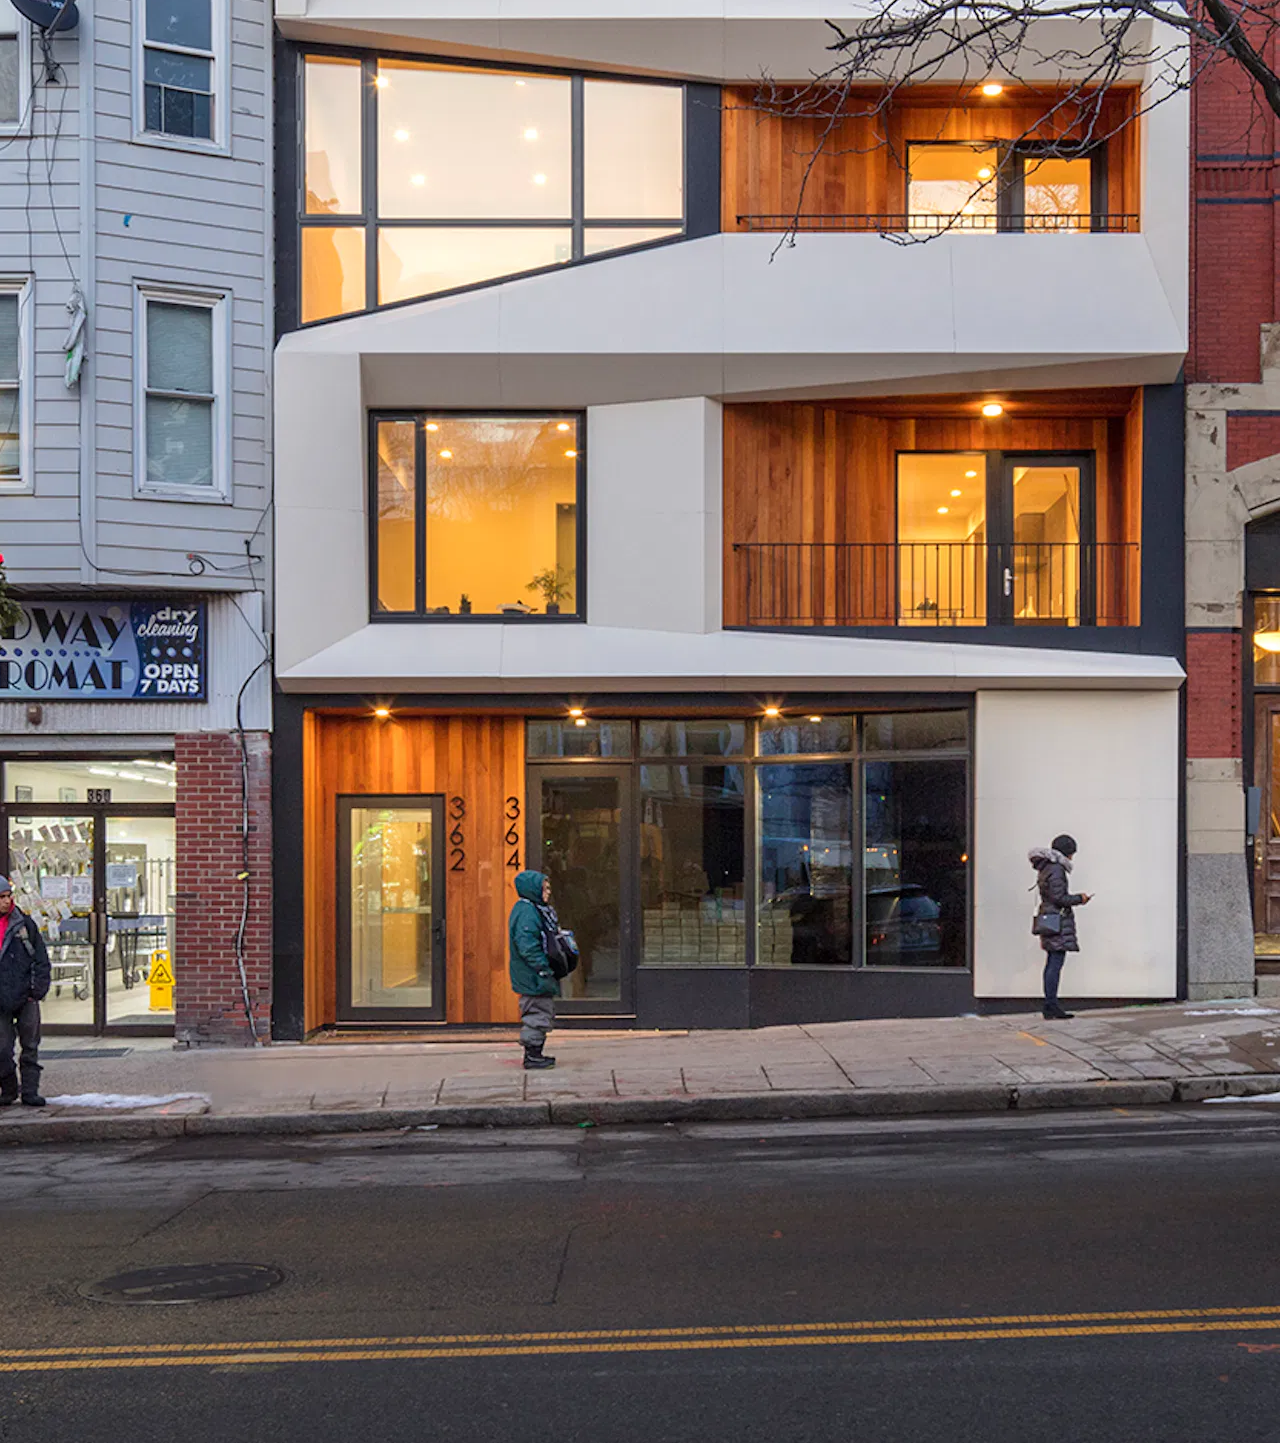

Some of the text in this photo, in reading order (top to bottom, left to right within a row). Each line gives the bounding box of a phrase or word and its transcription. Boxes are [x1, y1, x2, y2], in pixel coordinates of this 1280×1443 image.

[156, 607, 197, 624] dry
[137, 614, 199, 643] cleaning
[144, 664, 199, 679] OPEN
[140, 680, 199, 693] 7 DAYS
